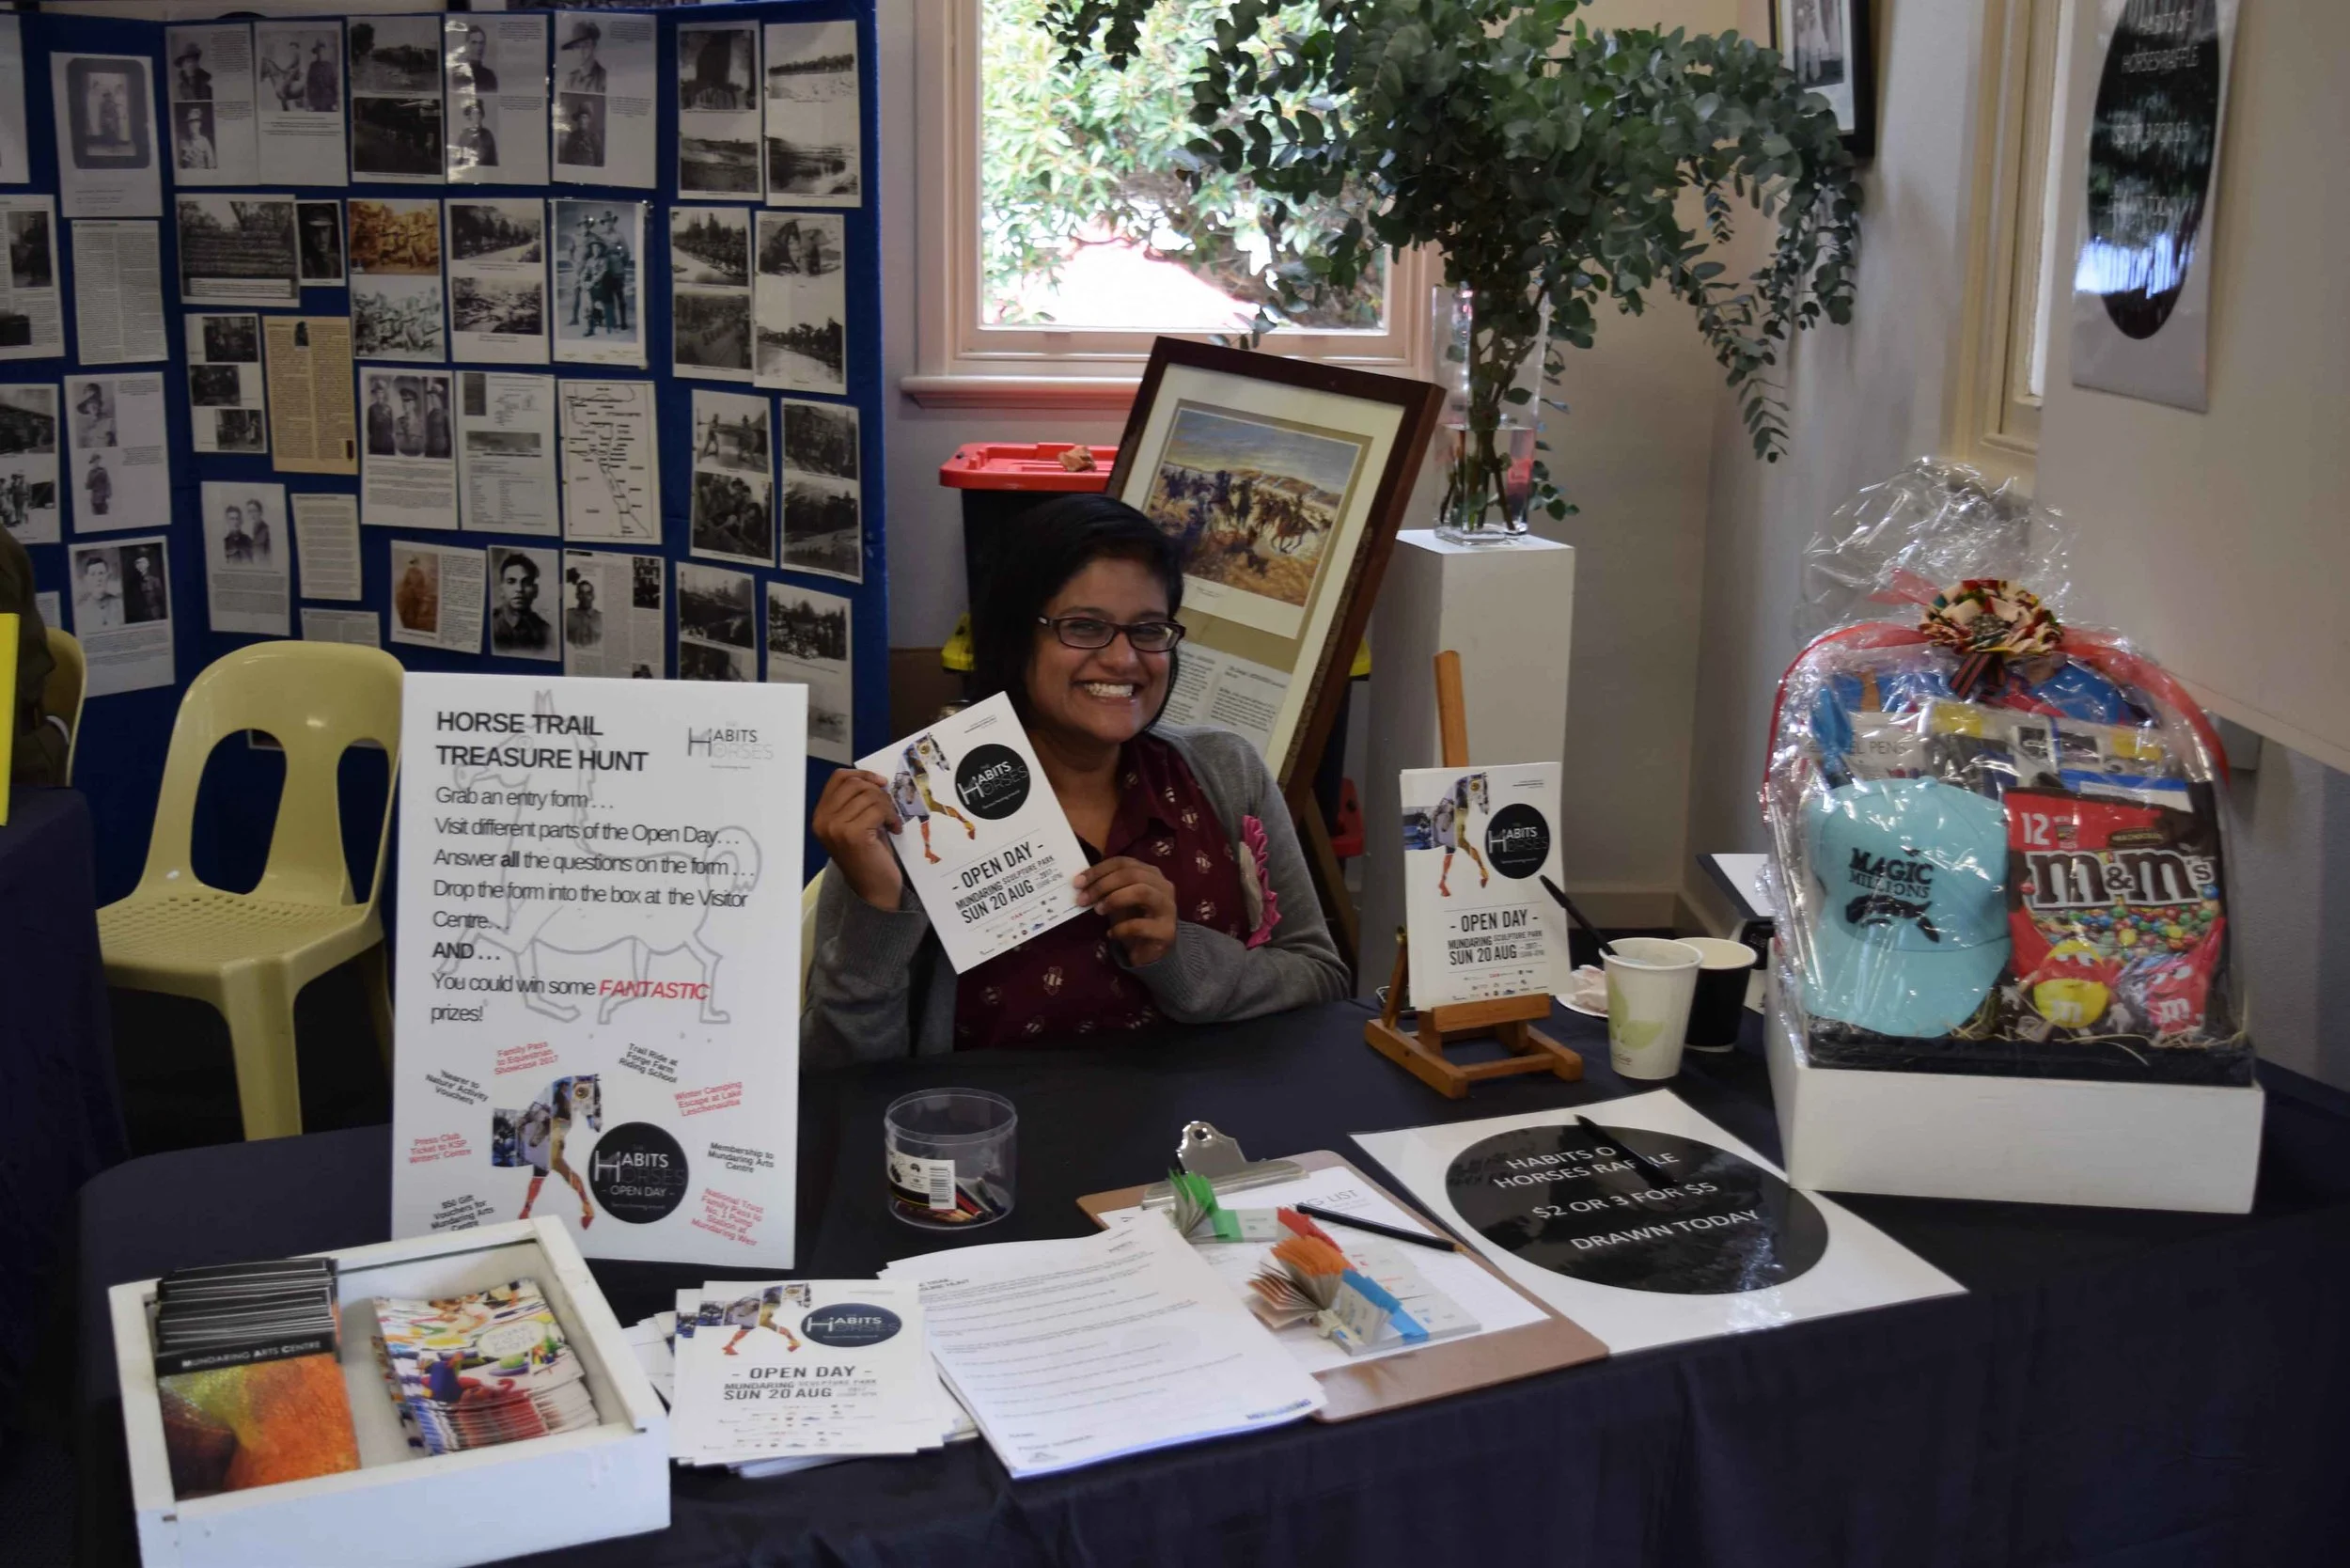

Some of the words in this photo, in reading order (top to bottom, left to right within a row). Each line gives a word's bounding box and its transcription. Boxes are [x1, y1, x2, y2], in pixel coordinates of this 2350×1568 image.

[436, 711, 525, 734] HORSE
[531, 713, 603, 736] TRAIL
[436, 745, 572, 770] TREASURE
[579, 748, 649, 772] HUNT
[435, 787, 478, 806] Grab
[481, 792, 503, 807] an
[507, 791, 545, 811] entry
[435, 817, 469, 836] Visit
[472, 818, 536, 838] different
[539, 820, 581, 843] parts
[583, 820, 601, 839] of
[603, 821, 629, 840] the
[632, 823, 680, 846] Open
[2021, 812, 2050, 845] 12
[433, 849, 498, 869] Answer
[501, 850, 521, 868] all
[524, 851, 550, 870] the
[553, 852, 633, 875] questions
[635, 856, 658, 873] on
[661, 854, 687, 874] the
[961, 856, 1003, 888] OPEN
[1002, 841, 1033, 868] DAY
[1848, 847, 1935, 886] MAGIC
[433, 880, 475, 902] Drop
[478, 881, 504, 900] the
[507, 881, 545, 901] form
[548, 883, 577, 902] into
[580, 884, 607, 903] the
[611, 886, 641, 904] box
[644, 887, 661, 905] at
[668, 886, 695, 906] the
[697, 887, 749, 909] Visitor
[1848, 870, 1932, 899] MILLIONS
[955, 881, 1004, 911] MUNDARING
[961, 901, 990, 924] SUN
[989, 891, 1009, 910] 20
[1008, 879, 1035, 902] AUG
[1461, 912, 1497, 933] OPEN
[1502, 909, 1528, 928] DAY
[432, 942, 474, 961] AND
[1448, 935, 1493, 949] MUNDARING
[1449, 949, 1473, 965] SUN
[1477, 947, 1492, 963] 20
[1494, 944, 1517, 960] AUG
[431, 972, 466, 992] You
[469, 972, 513, 994] could
[516, 975, 545, 995] win
[548, 979, 596, 996] some
[599, 979, 710, 1001] FANTASTIC
[431, 1003, 483, 1026] prizes!
[496, 1045, 525, 1057] Family
[526, 1041, 549, 1051] Pass
[507, 1049, 554, 1063] Equestrian
[629, 1043, 648, 1056] Trail
[649, 1049, 667, 1062] Ride
[494, 1060, 537, 1075] Showcase
[539, 1054, 559, 1066] 2017
[619, 1058, 646, 1074] Riding
[648, 1068, 678, 1083] School
[626, 1051, 651, 1066] Forge
[652, 1060, 675, 1074] Farm
[457, 1085, 489, 1103] Activity
[470, 1080, 480, 1089] to
[674, 1090, 702, 1101] Winter
[704, 1081, 743, 1095] Camping
[435, 1086, 474, 1105] Vouchers
[678, 1096, 709, 1108] Escape
[721, 1090, 742, 1100] Lake
[410, 1145, 437, 1154] Ticket
[448, 1139, 467, 1149] KSP
[415, 1137, 438, 1146] Press
[440, 1133, 461, 1141] Club
[711, 1142, 763, 1158] Membership
[443, 1149, 472, 1158] Centre
[708, 1150, 753, 1166] Mundaring
[756, 1158, 774, 1168] Arts
[1506, 1149, 1593, 1170] HABITS
[1595, 1146, 1617, 1157] O
[726, 1162, 755, 1173] Centre
[1493, 1166, 1591, 1189] HORSES
[1591, 1152, 1681, 1174] RAFLE
[458, 1195, 475, 1204] Gift
[610, 1184, 643, 1196] OPEN
[644, 1186, 667, 1197] DAY
[1325, 1188, 1359, 1202] LIST
[1531, 1204, 1568, 1220] $2
[1568, 1198, 1610, 1214] OR
[1608, 1195, 1630, 1207] 3
[1631, 1186, 1685, 1203] FOR
[1684, 1181, 1718, 1199] $5
[431, 1212, 476, 1230] Mundaring
[477, 1207, 494, 1216] Arts
[433, 1205, 474, 1220] Vouchers
[691, 1218, 736, 1240] Mundaring
[738, 1235, 758, 1246] Weir
[1569, 1222, 1674, 1251] DRAWN
[1676, 1208, 1761, 1232] TODAY
[181, 1351, 251, 1369] MUNDARING
[253, 1347, 280, 1358] ARTS
[280, 1340, 321, 1355] CENTRE
[749, 1366, 807, 1379] OPEN
[815, 1365, 856, 1378] DAY
[723, 1388, 762, 1402] SUN
[768, 1388, 791, 1400] 20
[795, 1387, 833, 1399] AUG
[724, 1381, 795, 1391] MUNDARING
